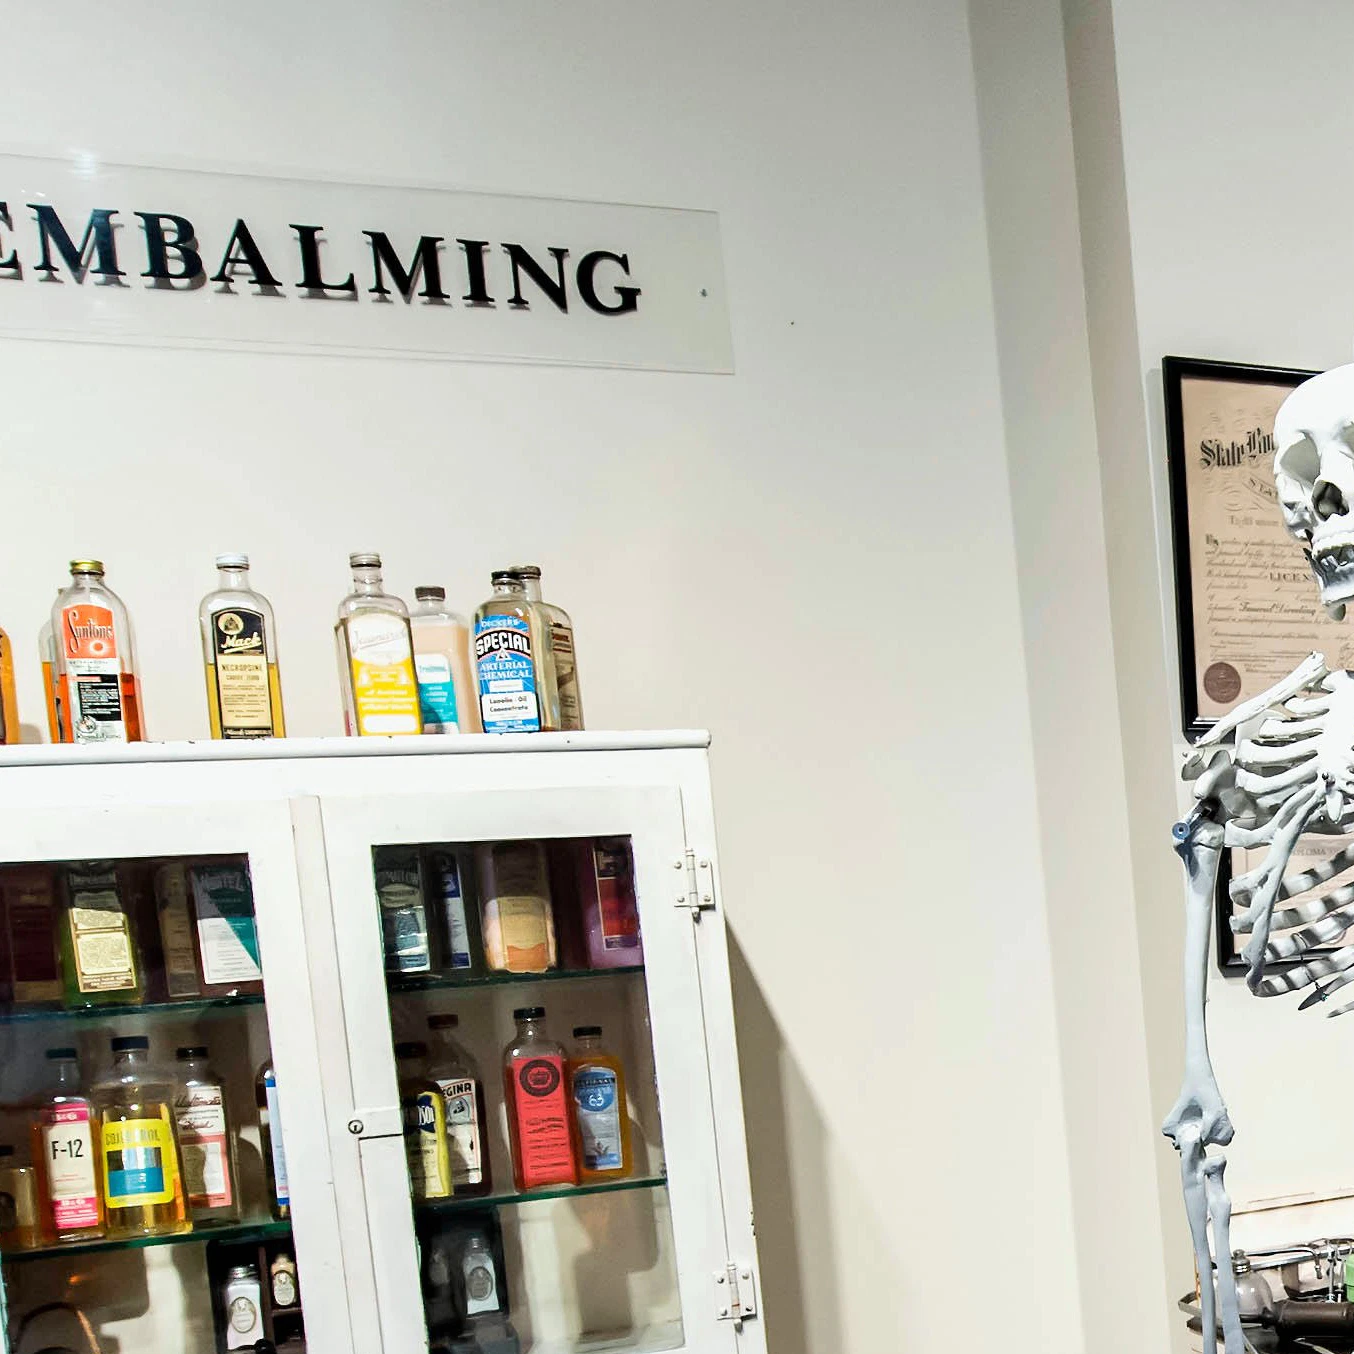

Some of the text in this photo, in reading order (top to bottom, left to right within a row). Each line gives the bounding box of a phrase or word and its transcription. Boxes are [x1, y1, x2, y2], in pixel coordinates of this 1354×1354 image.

[1200, 439, 1245, 472] State
[220, 631, 263, 649] Mack
[476, 632, 531, 656] SPECIAL
[442, 1082, 473, 1098] EGINA
[50, 1138, 84, 1160] F-12
